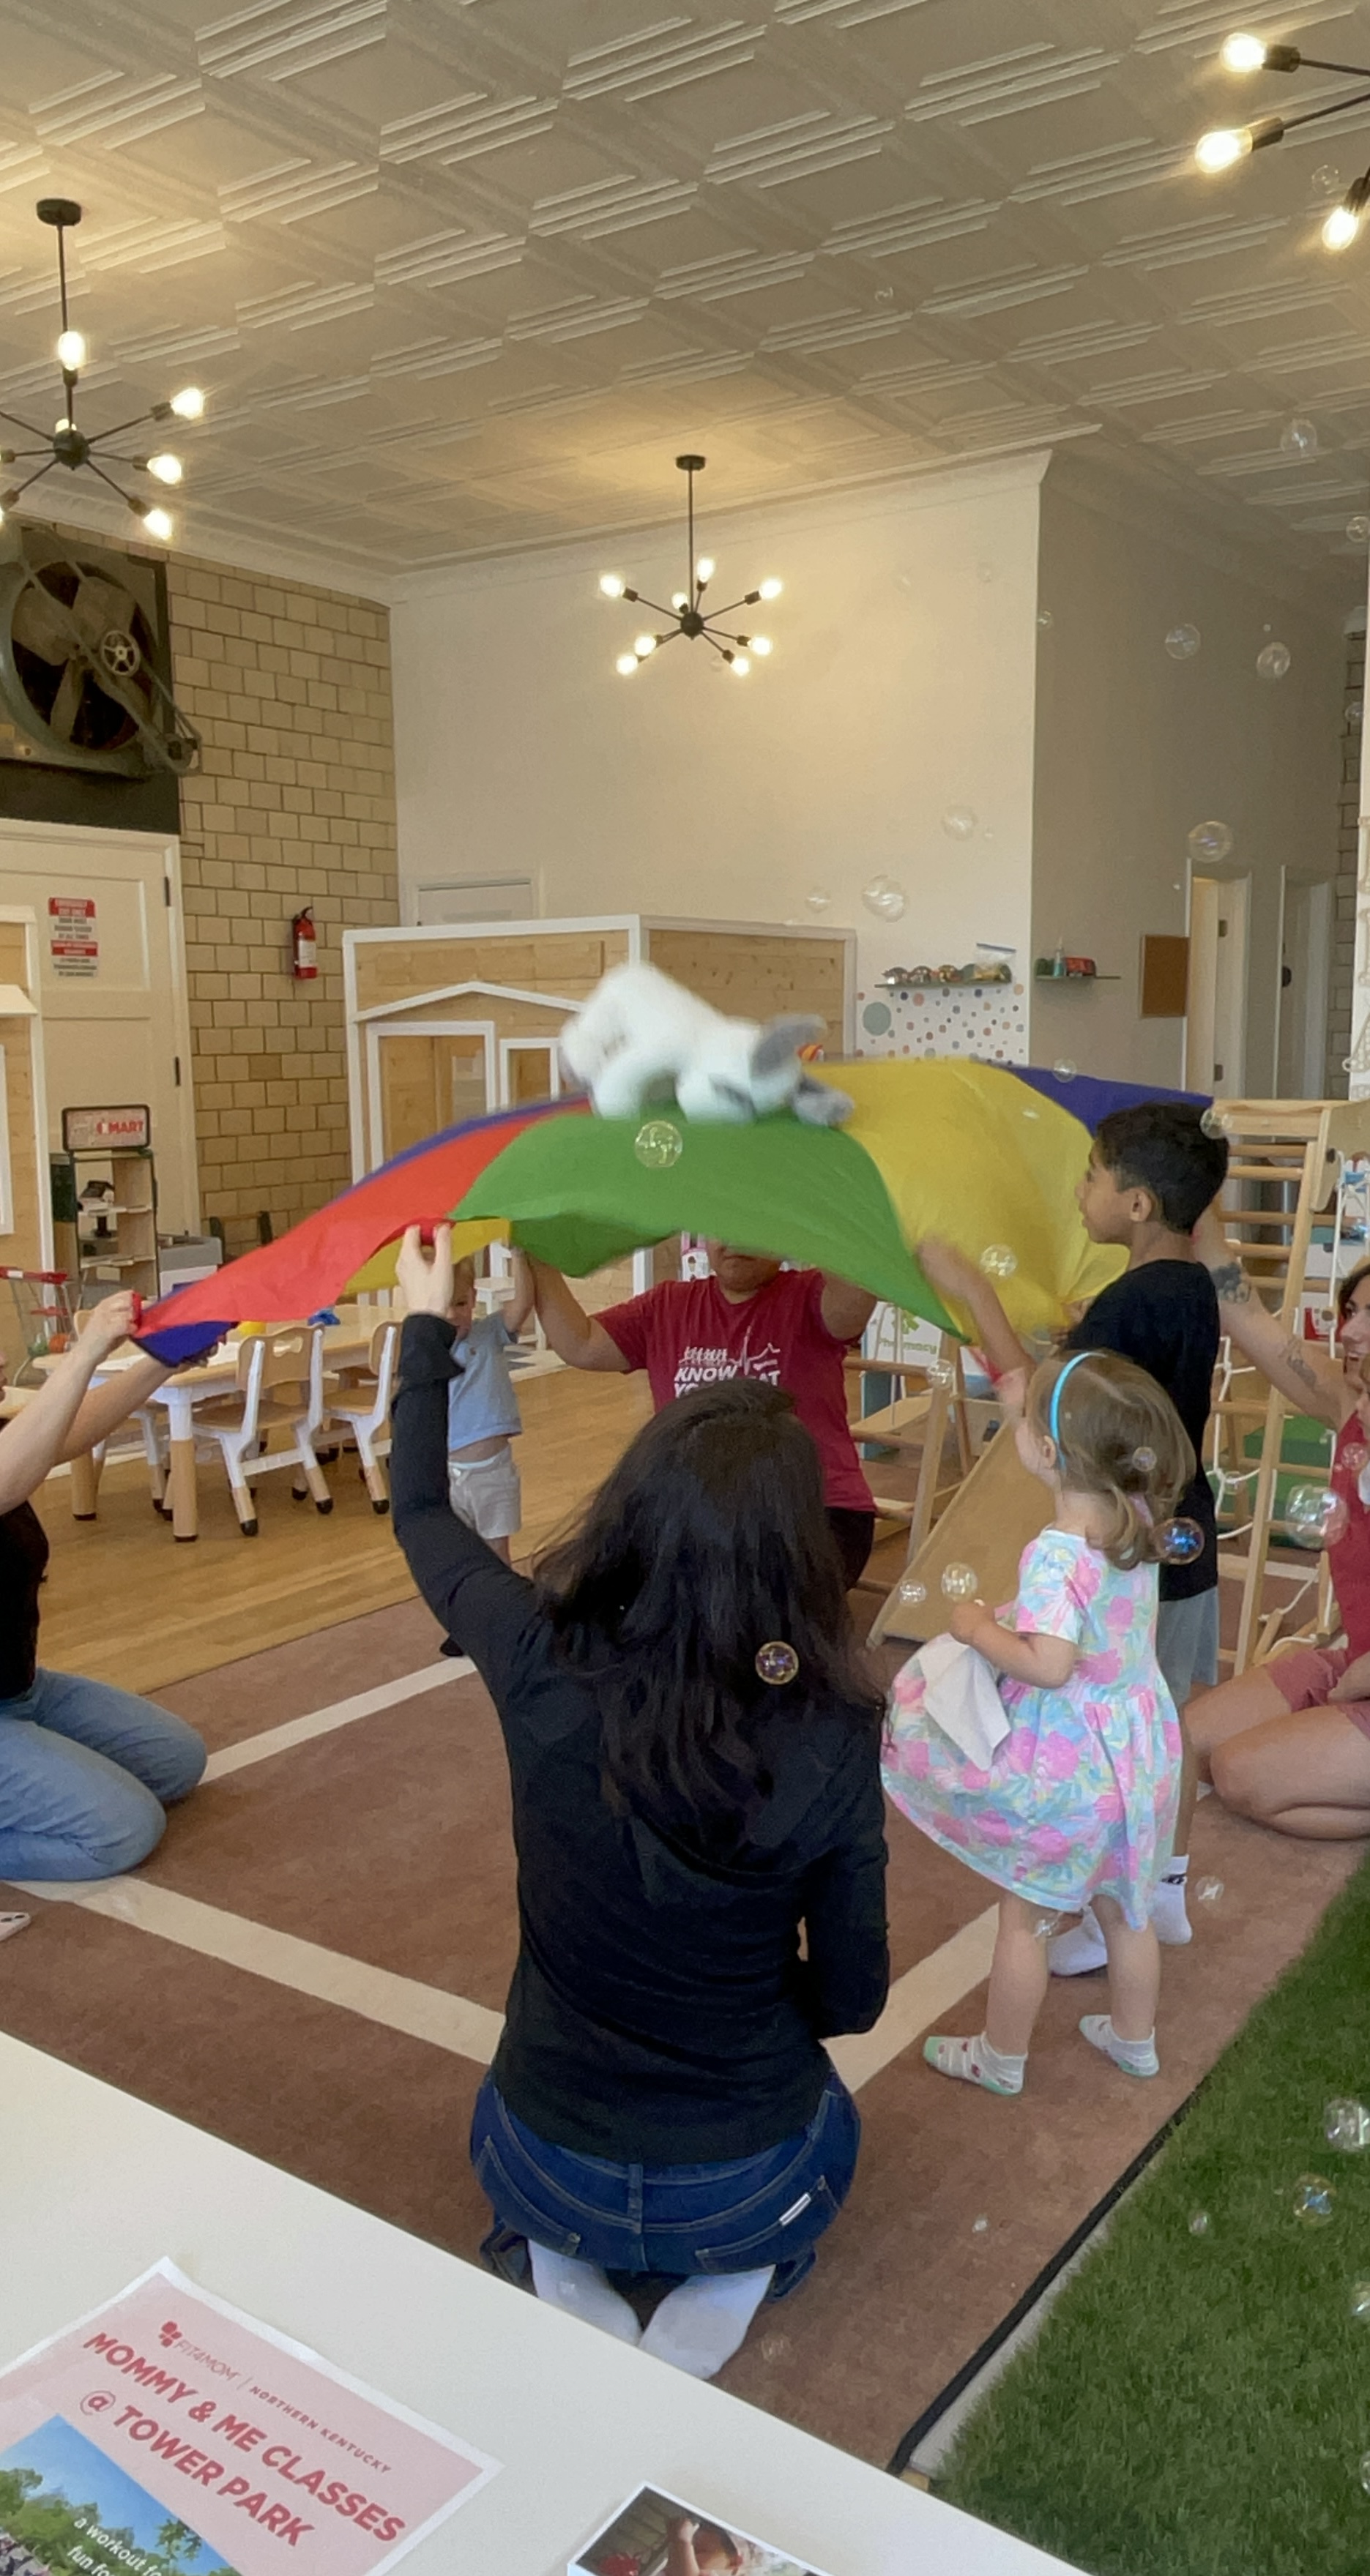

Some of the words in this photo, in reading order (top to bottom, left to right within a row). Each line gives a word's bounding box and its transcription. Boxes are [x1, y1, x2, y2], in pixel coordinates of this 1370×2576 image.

[674, 1364, 737, 1382] KNOW
[83, 2332, 198, 2404] MOMMY
[188, 2400, 217, 2423] &
[211, 2413, 268, 2453] ME
[261, 2445, 406, 2542] CLASSES
[173, 2339, 238, 2381] FIT4MOM
[249, 2385, 319, 2430] NORTHERN
[320, 2427, 392, 2474] KENTUCKY
[80, 2389, 116, 2416] @
[113, 2404, 226, 2487] TOWER
[216, 2476, 316, 2547] PARK
[67, 2545, 93, 2570] fun
[74, 2517, 87, 2529] a
[86, 2525, 147, 2572] workout
